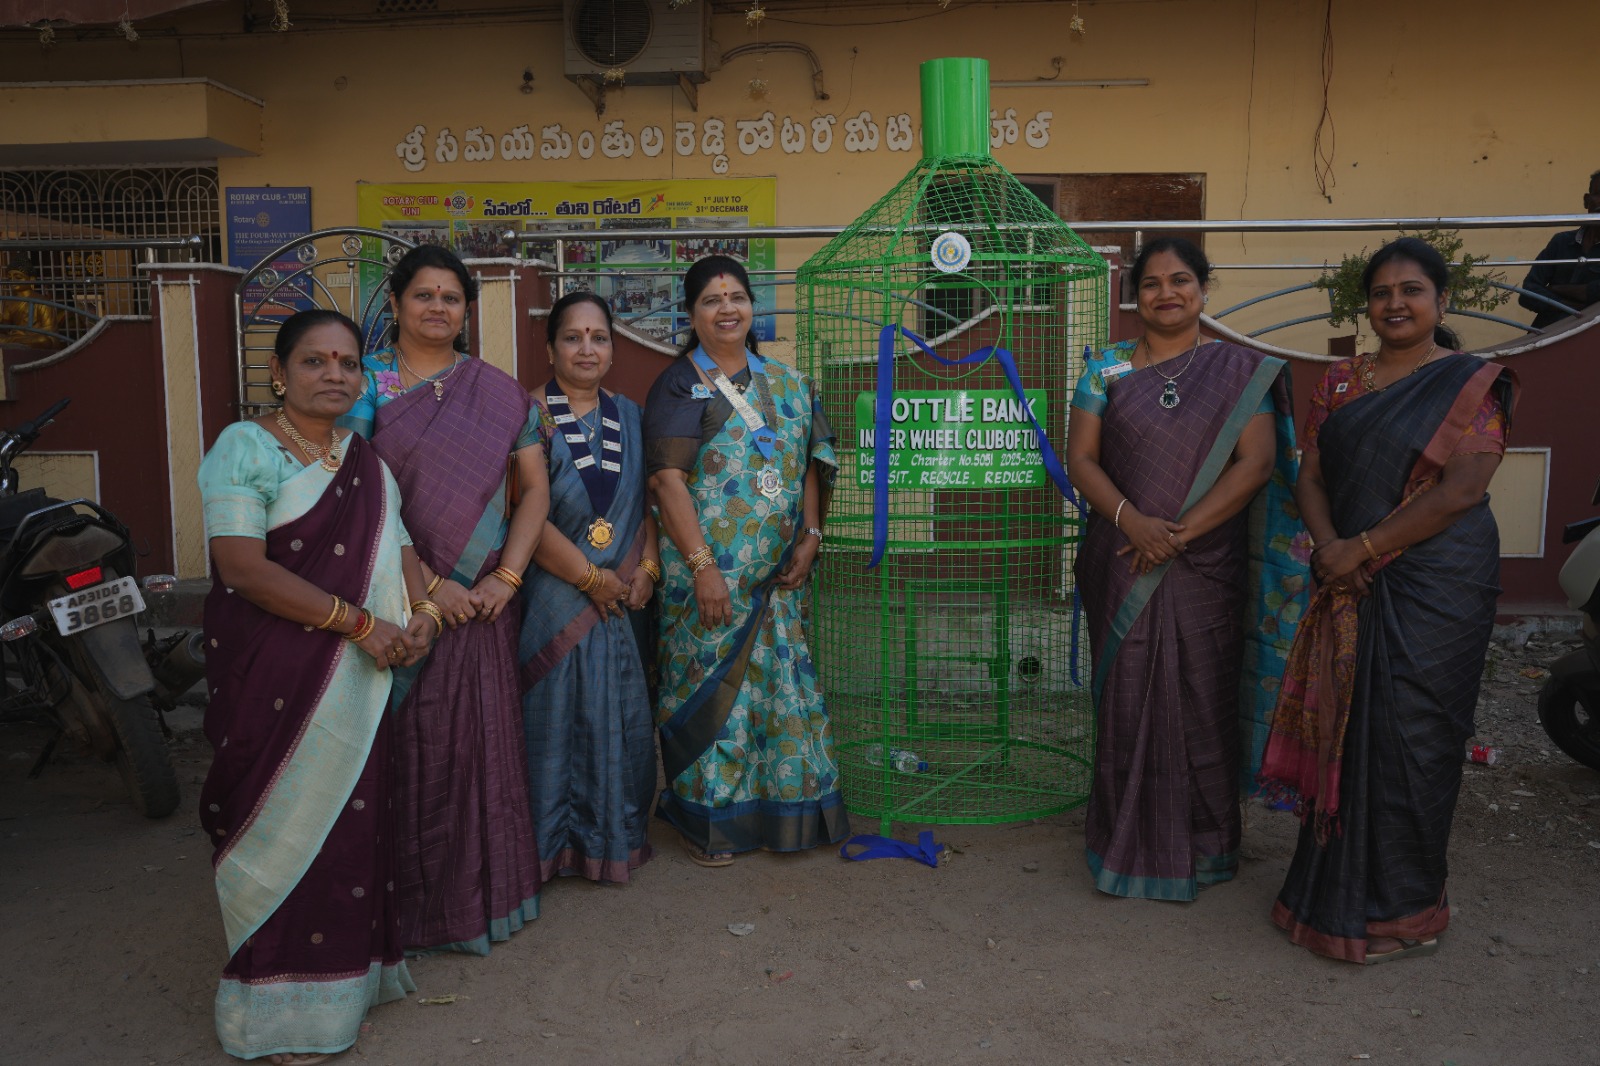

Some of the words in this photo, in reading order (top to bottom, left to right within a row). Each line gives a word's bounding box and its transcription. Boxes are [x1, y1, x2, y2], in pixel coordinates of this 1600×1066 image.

[396, 124, 427, 172] శ్రీ
[230, 193, 259, 201] ROTARY
[261, 193, 281, 201] CLUB
[383, 196, 415, 205] ROTARY
[417, 195, 439, 205] CLUB
[401, 207, 421, 216] TUNI
[555, 200, 589, 215] తుని
[593, 197, 641, 215] రోటరీ
[710, 205, 748, 213] DECEMBER
[233, 215, 256, 224] Rotary
[873, 397, 975, 422] OTTLE
[982, 397, 1036, 422] BANK
[859, 428, 906, 449] INER
[910, 429, 963, 449] WHEEL
[911, 453, 955, 466] Charter
[1000, 452, 1043, 466] 2025-2026
[860, 470, 912, 484] DESIT.
[66, 594, 134, 631] 3868
